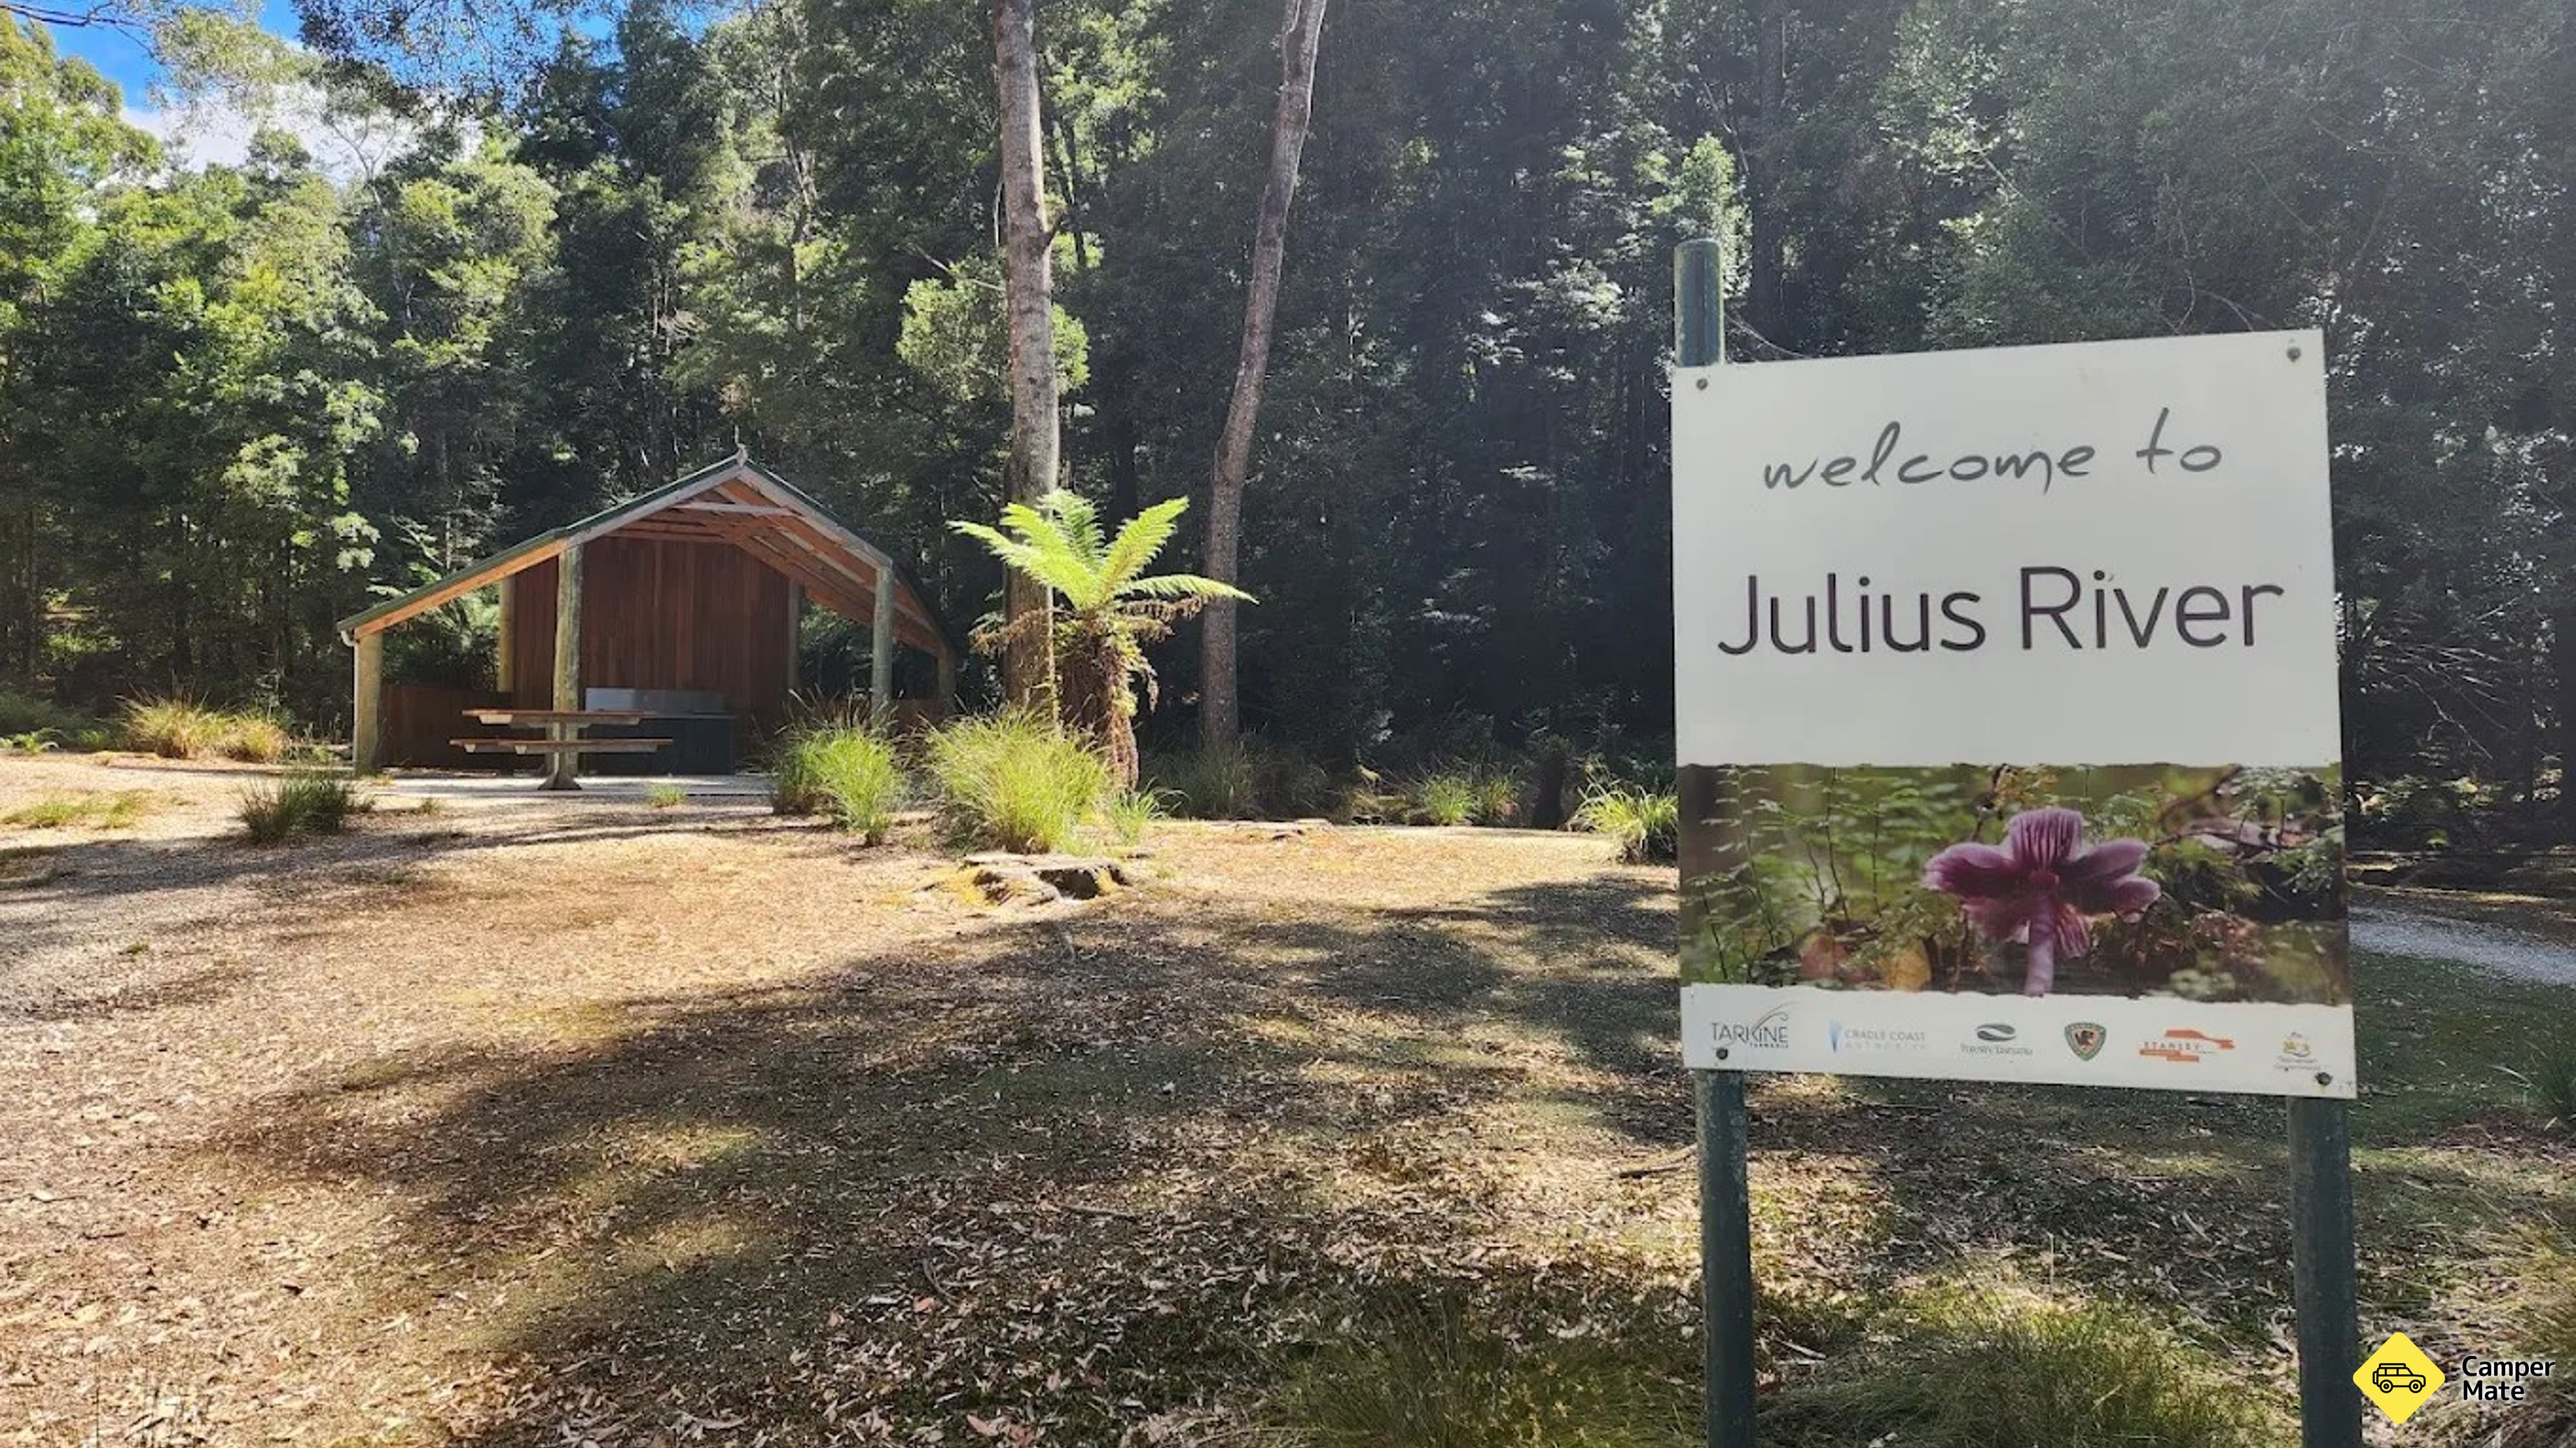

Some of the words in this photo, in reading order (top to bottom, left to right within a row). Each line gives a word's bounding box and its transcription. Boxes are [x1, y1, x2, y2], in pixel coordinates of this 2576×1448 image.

[1763, 420, 2096, 495] welcome
[2135, 406, 2223, 475] to
[1717, 571, 1987, 656] Julius
[2020, 565, 2285, 651] River
[1711, 1022, 1788, 1043] TARKINE
